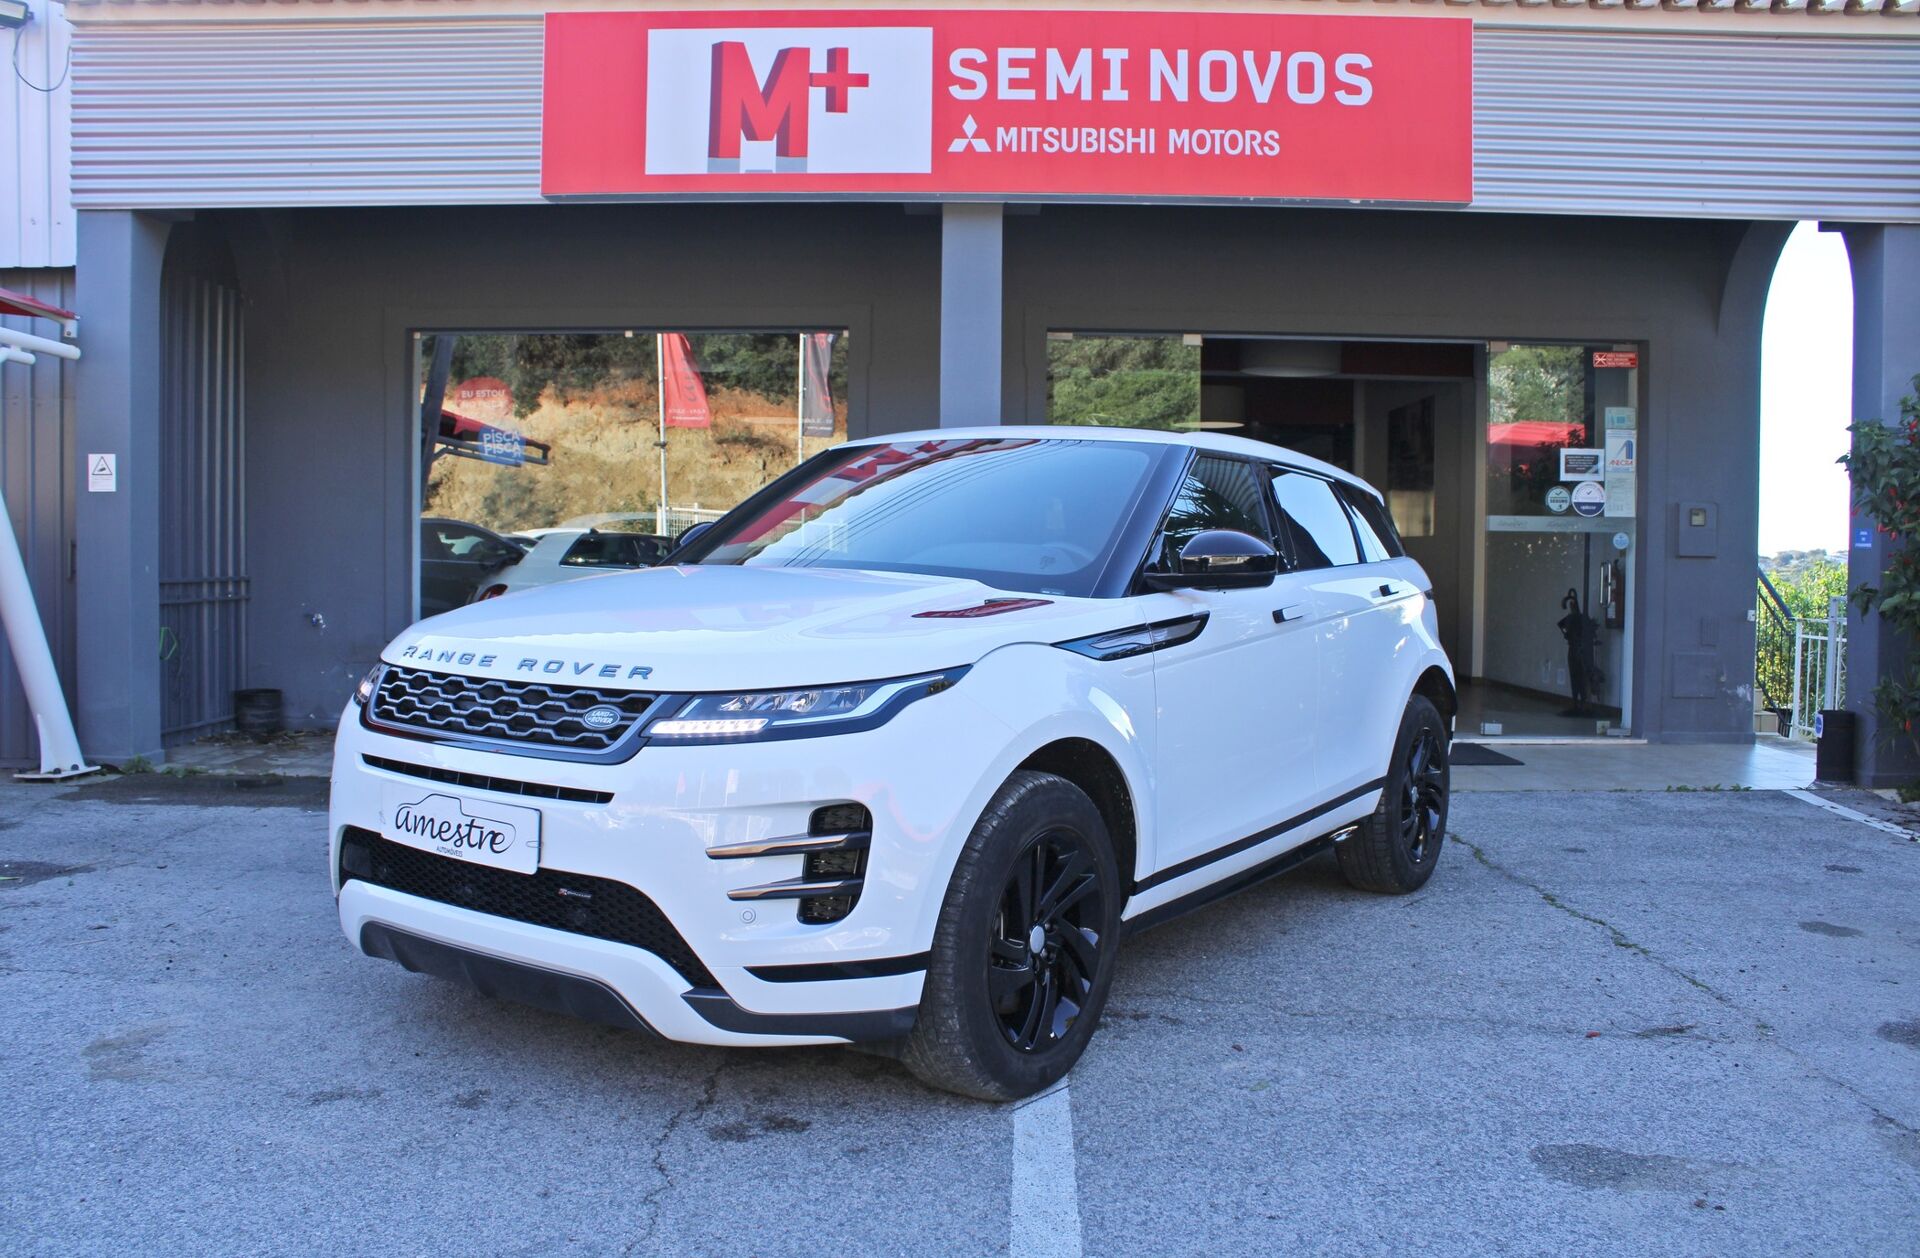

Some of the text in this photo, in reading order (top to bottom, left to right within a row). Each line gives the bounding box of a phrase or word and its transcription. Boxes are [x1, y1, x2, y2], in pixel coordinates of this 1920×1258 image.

[947, 47, 1374, 106] SEMI NOVOS
[708, 41, 870, 158] M+
[996, 126, 1281, 156] MITSUBISHI MOTORS
[461, 389, 506, 399] EU ESTOU
[402, 645, 654, 681] RANGE ROVER
[395, 805, 507, 854] amestre
